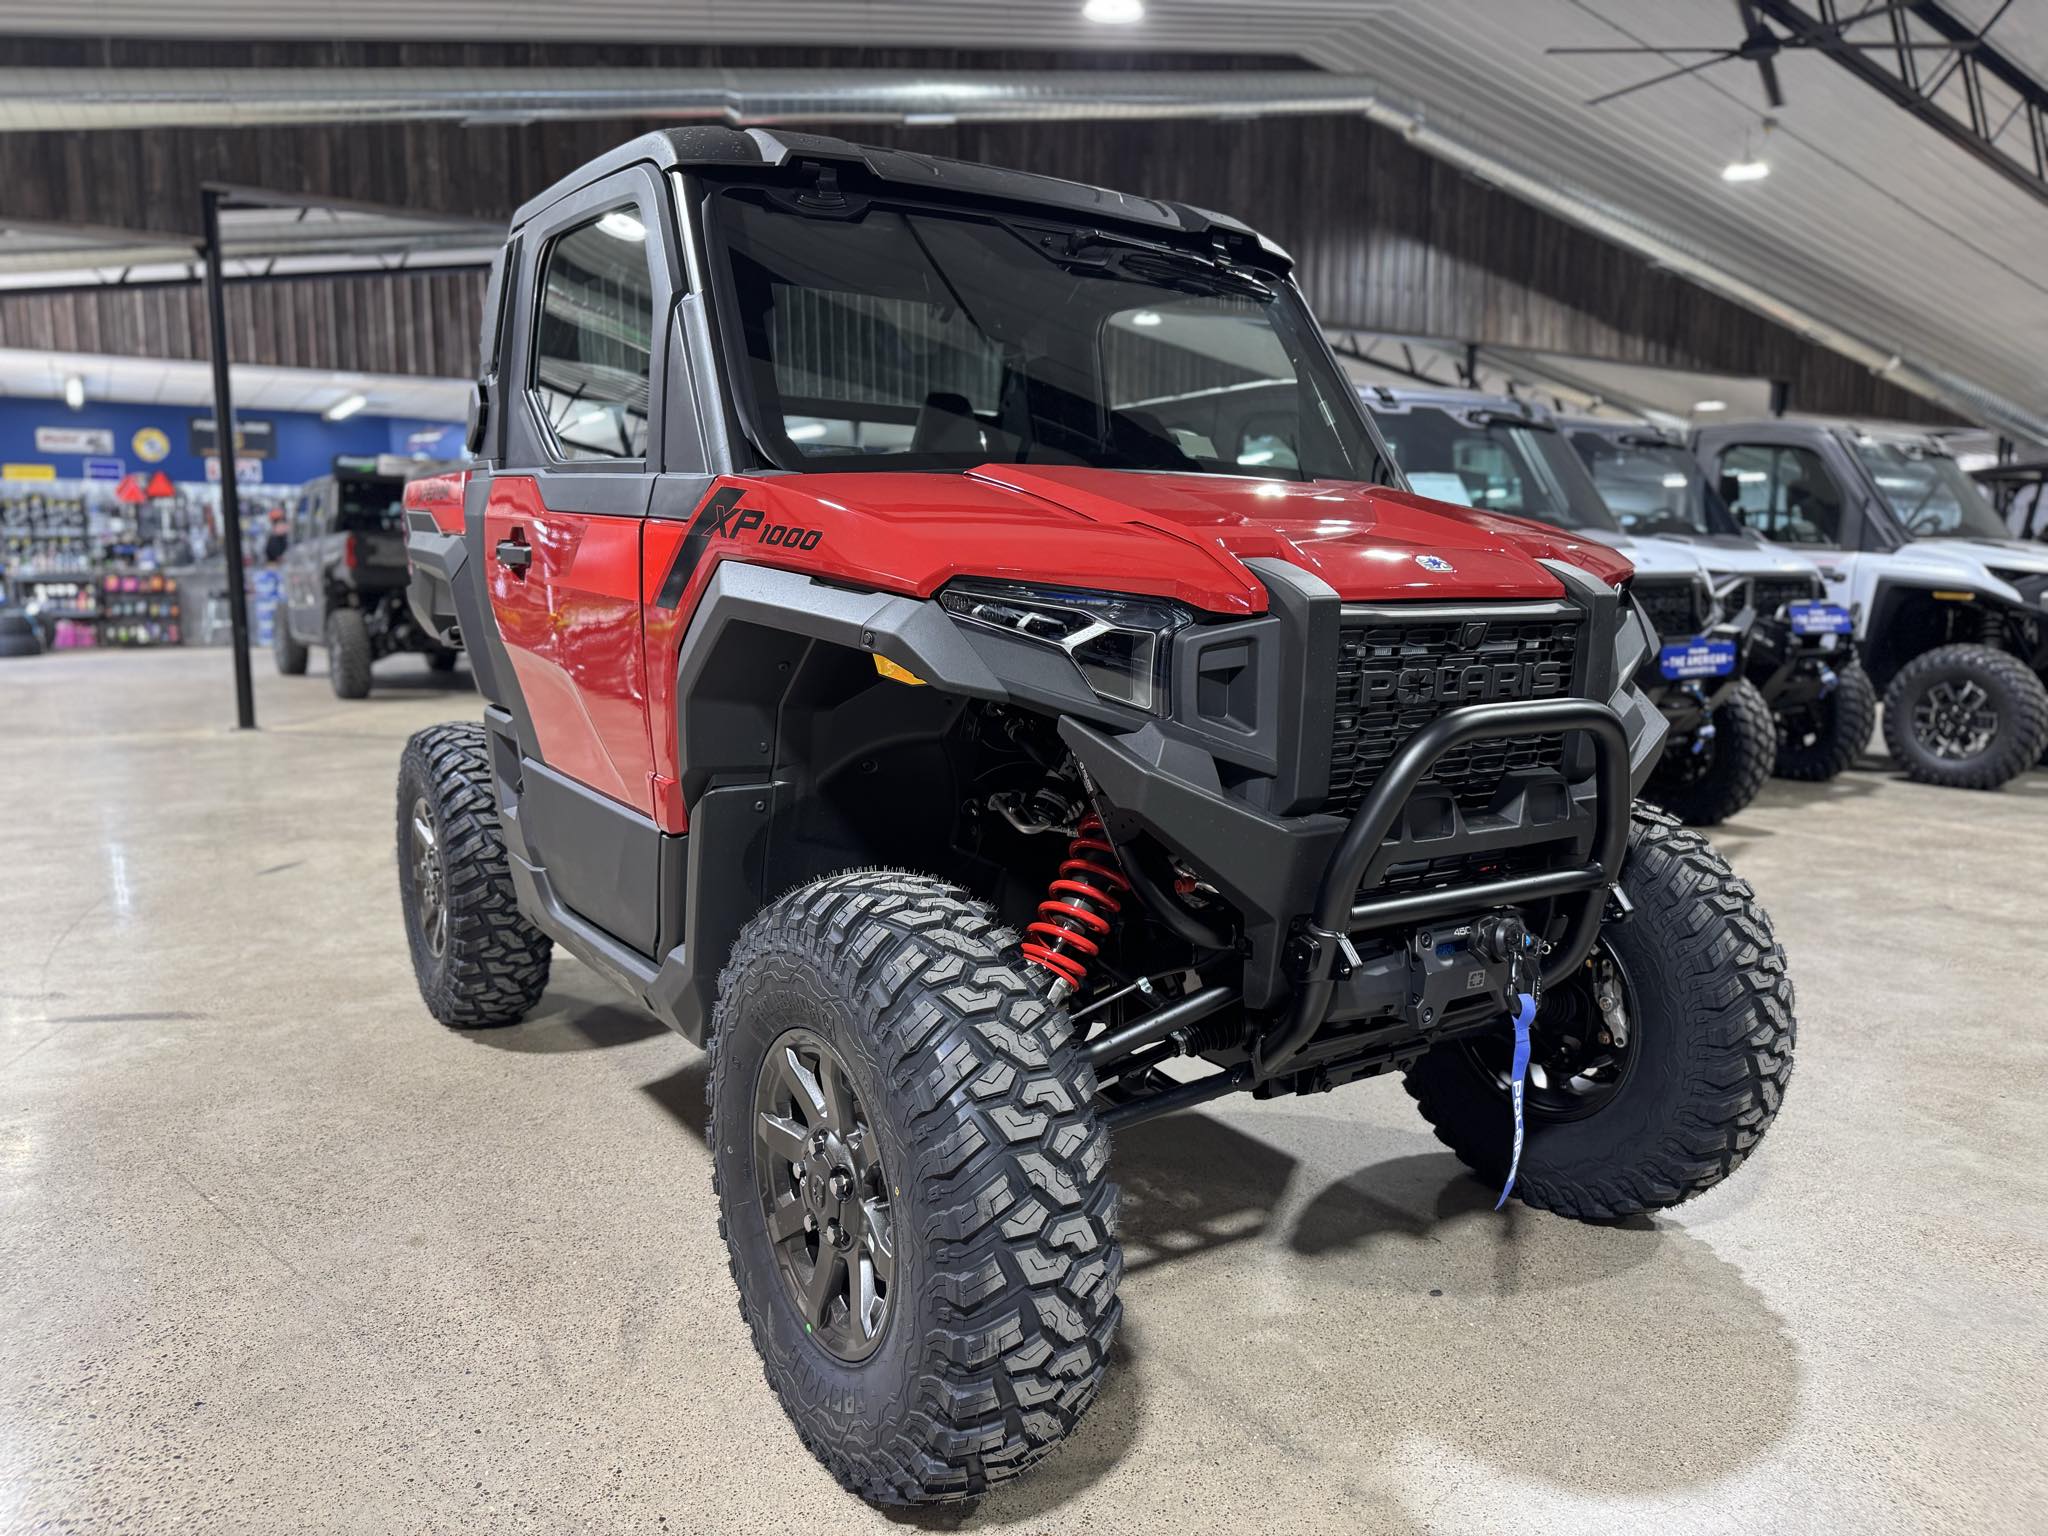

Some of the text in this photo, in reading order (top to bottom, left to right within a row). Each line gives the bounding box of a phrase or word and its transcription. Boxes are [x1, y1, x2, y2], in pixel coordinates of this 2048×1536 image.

[704, 504, 824, 551] XP 1000
[1669, 653, 1728, 668] THE AMERICAN
[1360, 661, 1561, 708] POLARIS
